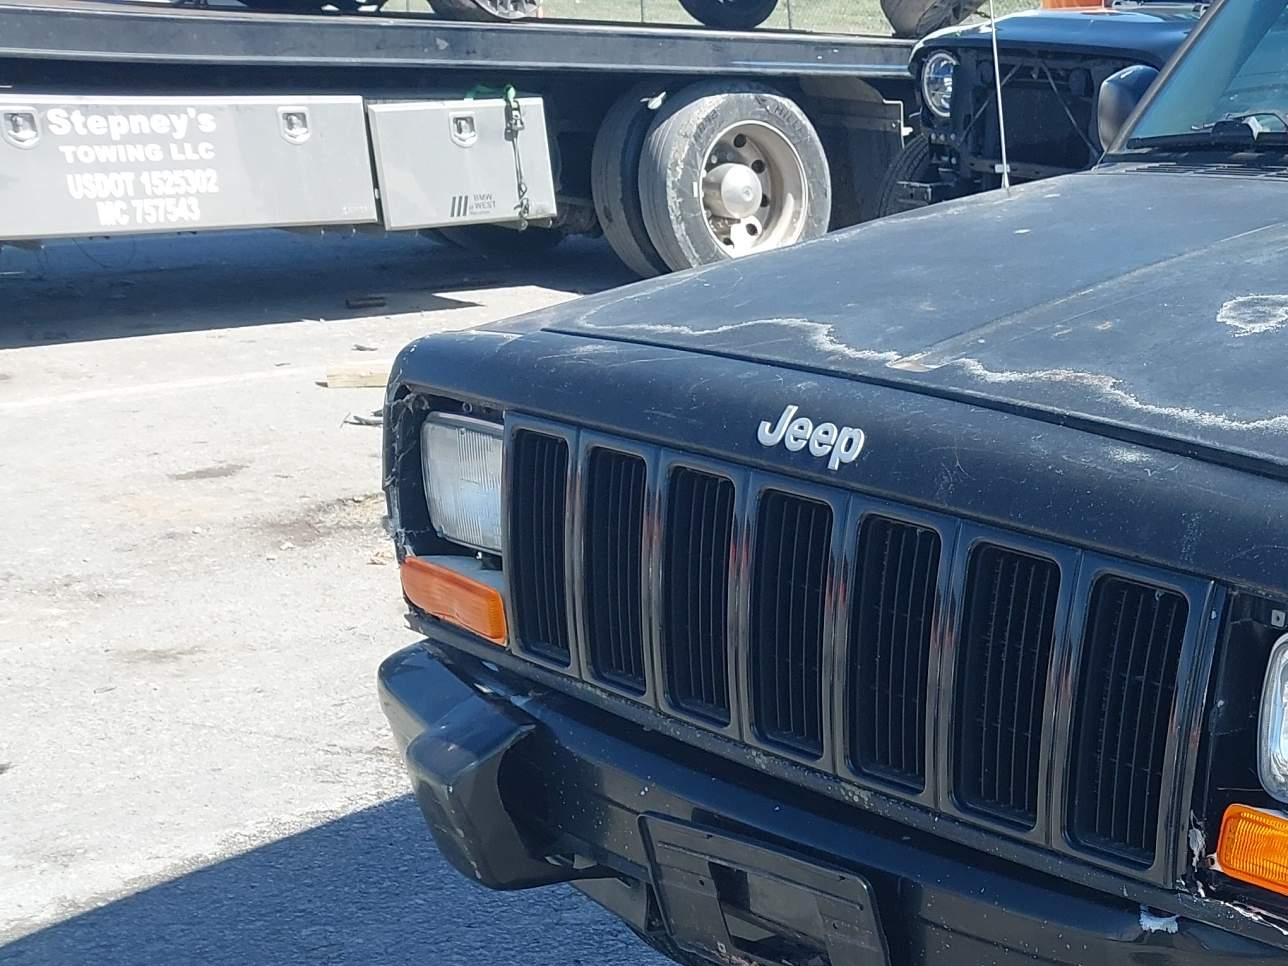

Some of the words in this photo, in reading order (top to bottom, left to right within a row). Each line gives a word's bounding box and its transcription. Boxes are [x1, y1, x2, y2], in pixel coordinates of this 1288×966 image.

[46, 107, 217, 141] Stepney's
[58, 144, 164, 164] TOWING
[169, 142, 216, 161] LLC
[65, 171, 136, 200] USDOT
[96, 200, 130, 226] MC
[757, 404, 865, 471] Jeep
